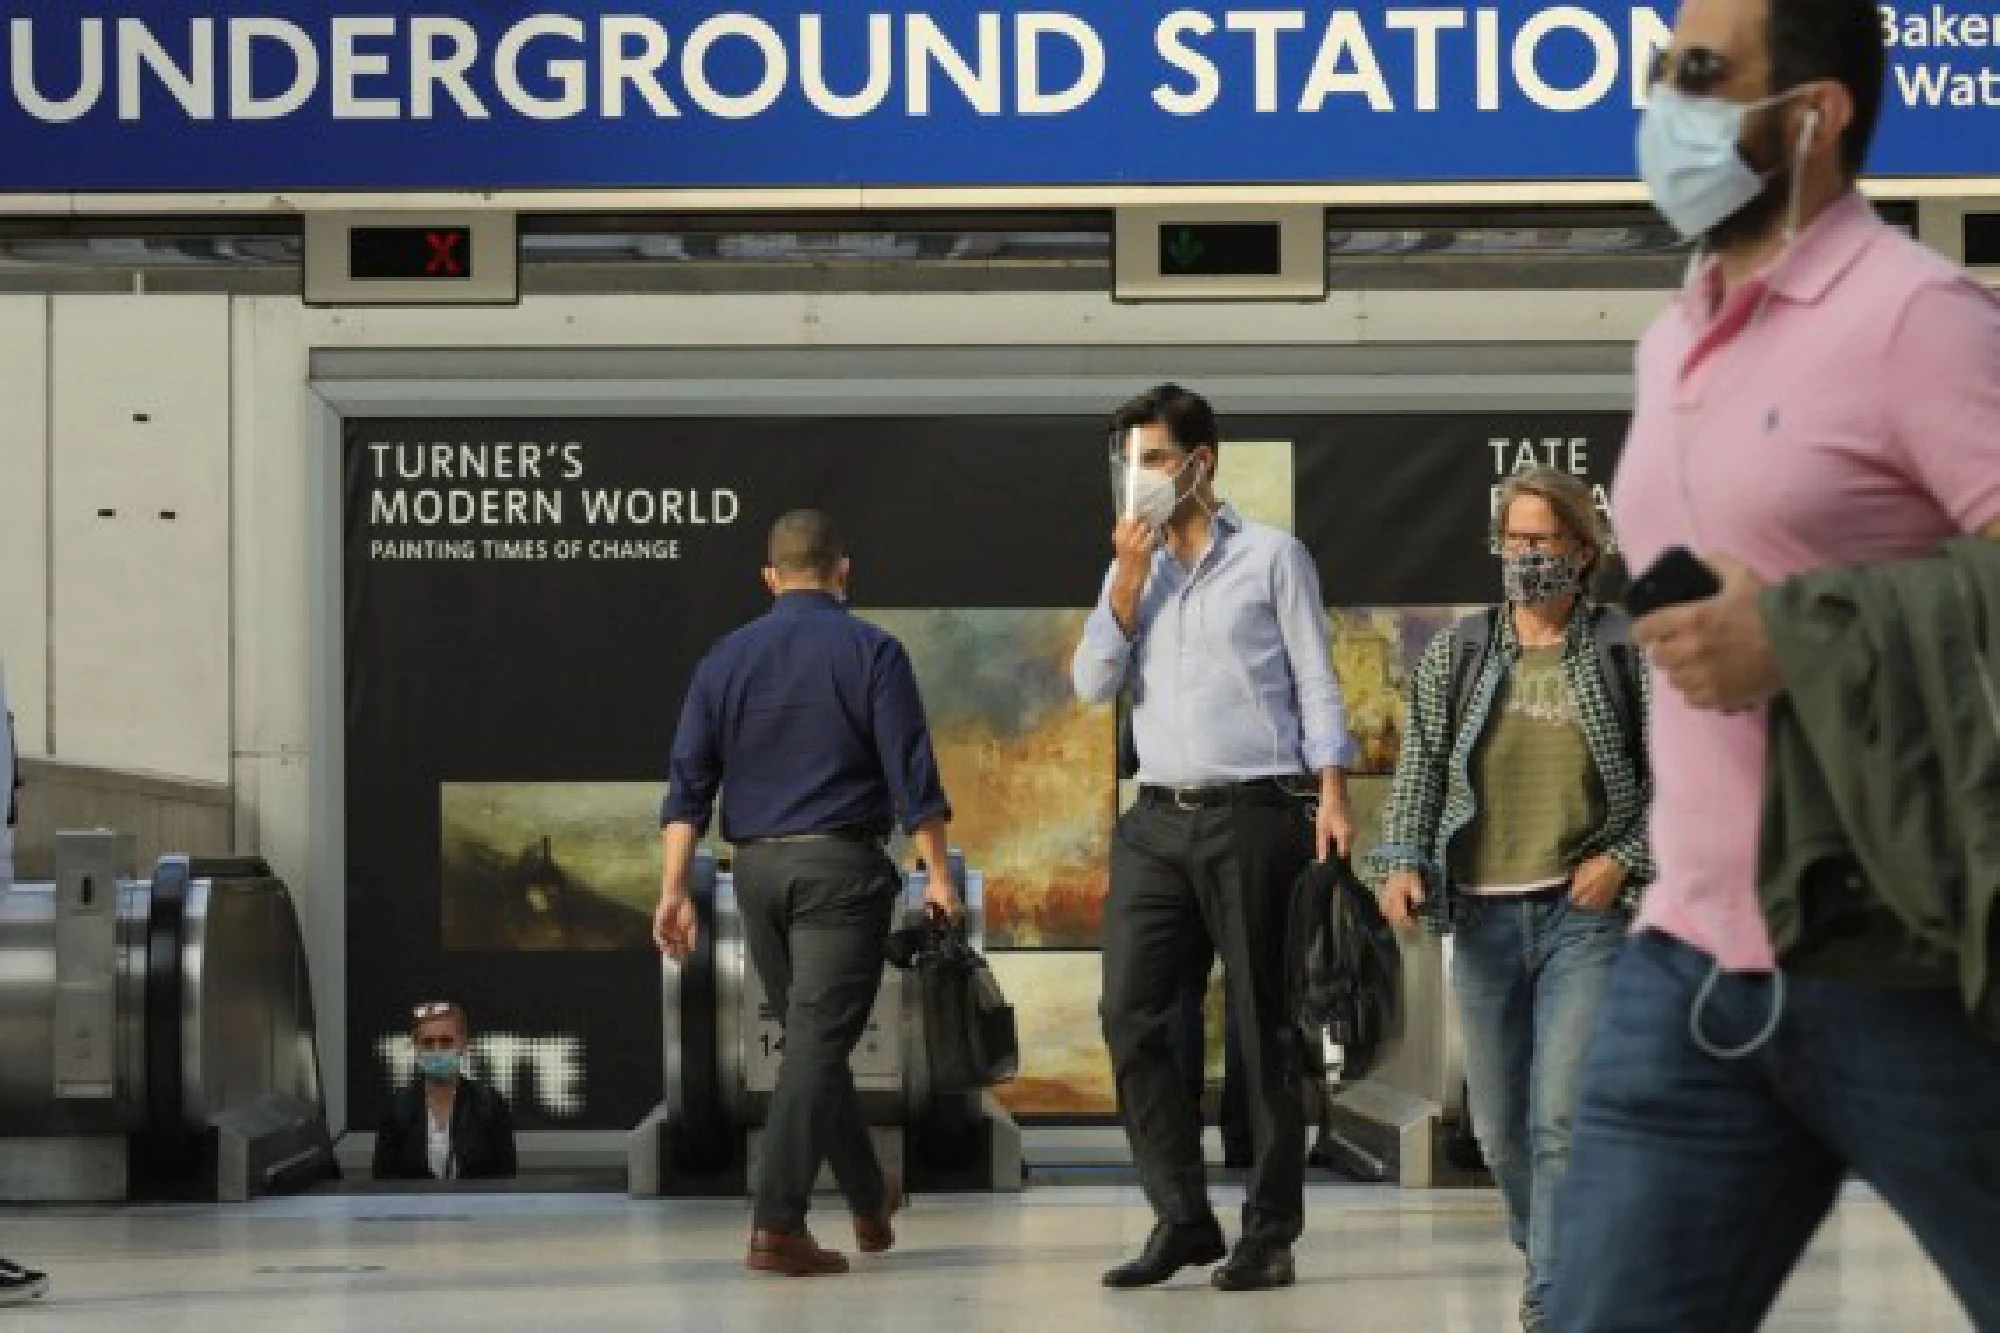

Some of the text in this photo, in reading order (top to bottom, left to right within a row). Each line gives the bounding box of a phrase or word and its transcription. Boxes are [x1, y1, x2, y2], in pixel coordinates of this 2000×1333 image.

[10, 14, 1106, 123] UNDERGROUND
[368, 442, 583, 481] TURNER'S
[1488, 438, 1588, 475] TATE
[370, 488, 740, 525] MODERN WORLD
[371, 540, 682, 560] PAINTING TIMES OF CHANGE
[374, 1031, 586, 1116] TTE
